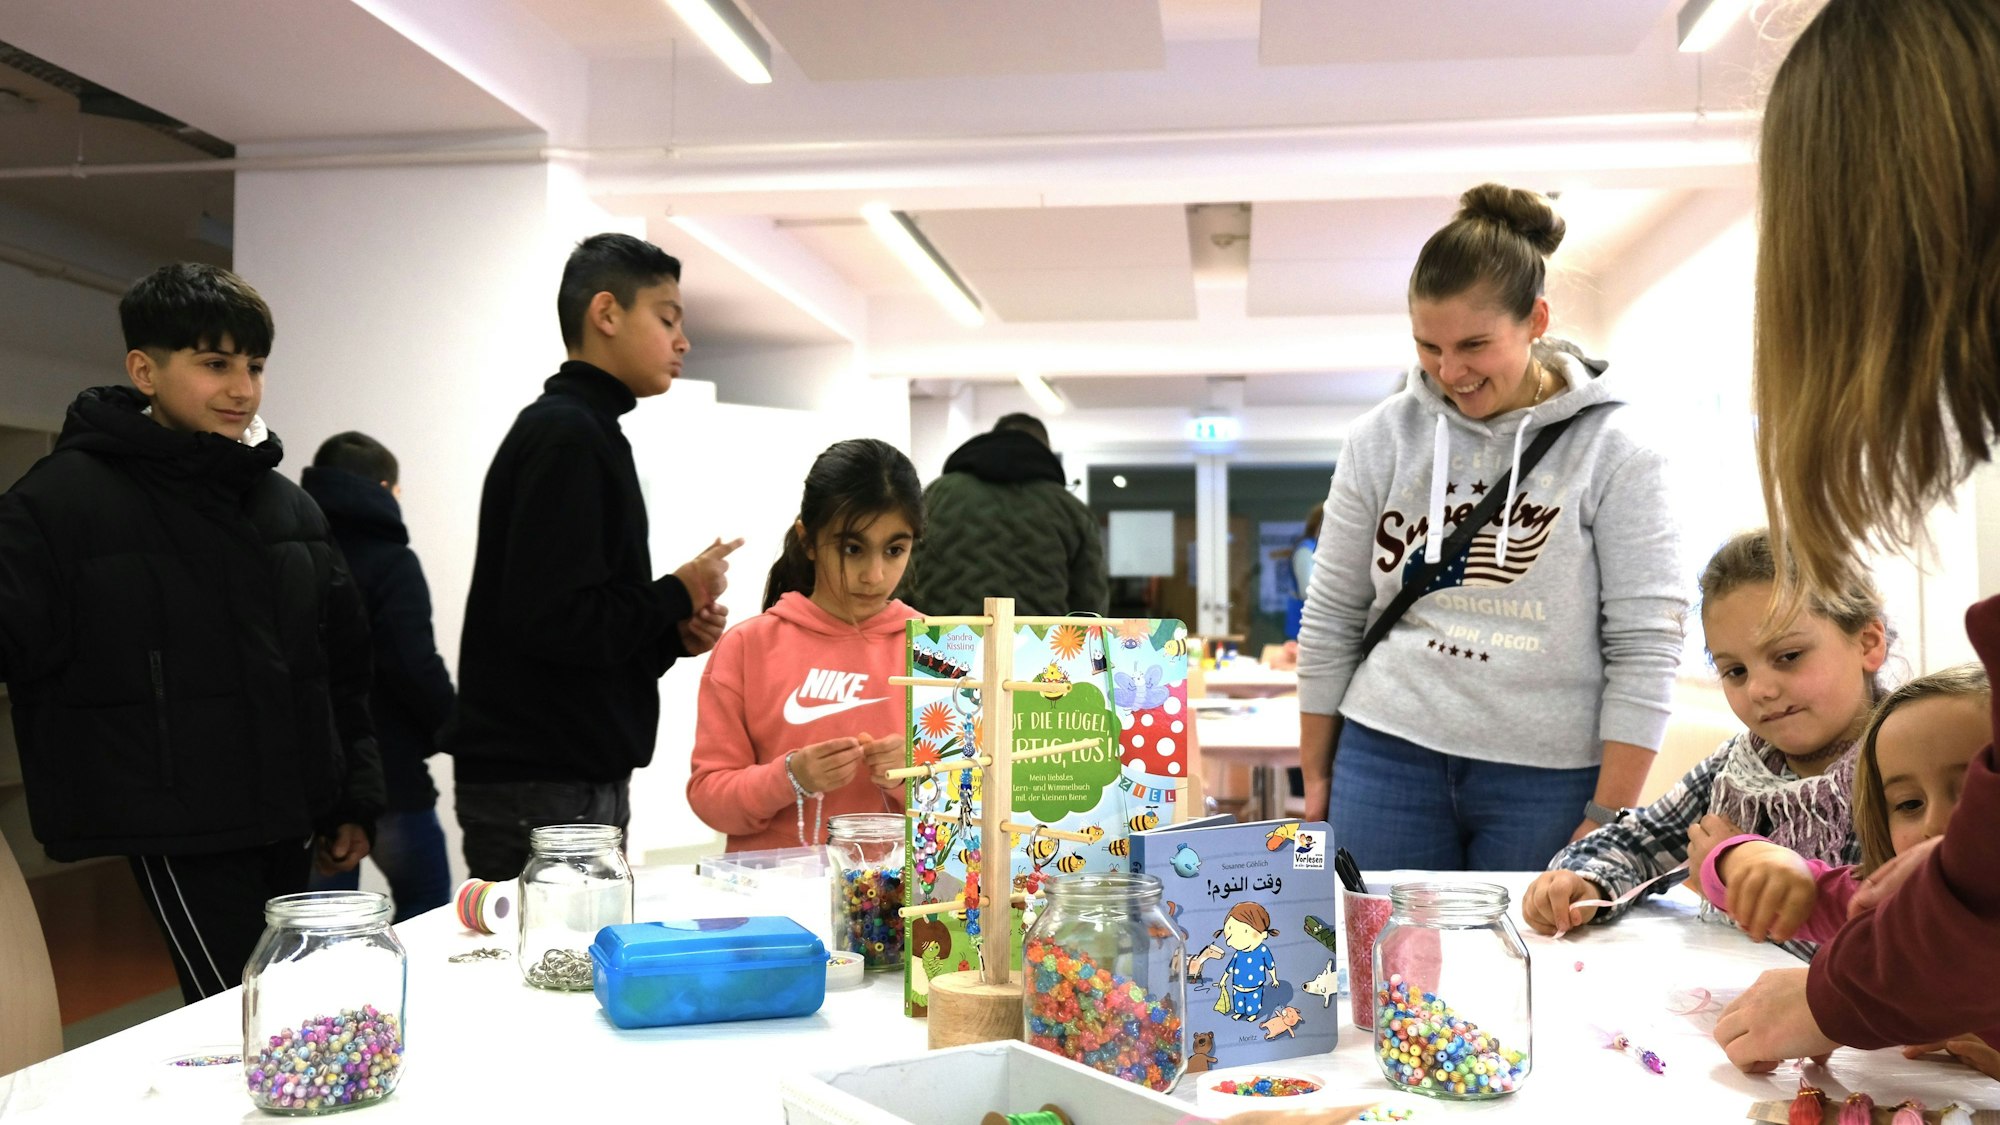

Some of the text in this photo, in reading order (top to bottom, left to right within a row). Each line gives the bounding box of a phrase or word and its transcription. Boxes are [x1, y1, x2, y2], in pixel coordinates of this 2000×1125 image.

[1435, 592, 1546, 621] ORIGINAL
[947, 633, 973, 641] Sandra
[947, 642, 975, 652] Kissling
[799, 668, 869, 702] NIKE
[1031, 711, 1053, 729] DIE
[1058, 709, 1110, 736] FLÜGEL,
[1047, 773, 1074, 781] liebstes
[1047, 782, 1091, 791] Wimmelbuch
[1120, 778, 1175, 801] ZIEL
[1015, 792, 1088, 802] mit der kleinen Biene
[1295, 853, 1323, 864] Vorlesen
[1246, 860, 1269, 868] Göhlich
[1207, 873, 1282, 903] وقت النوم!
[1239, 1034, 1258, 1042] Moritz
